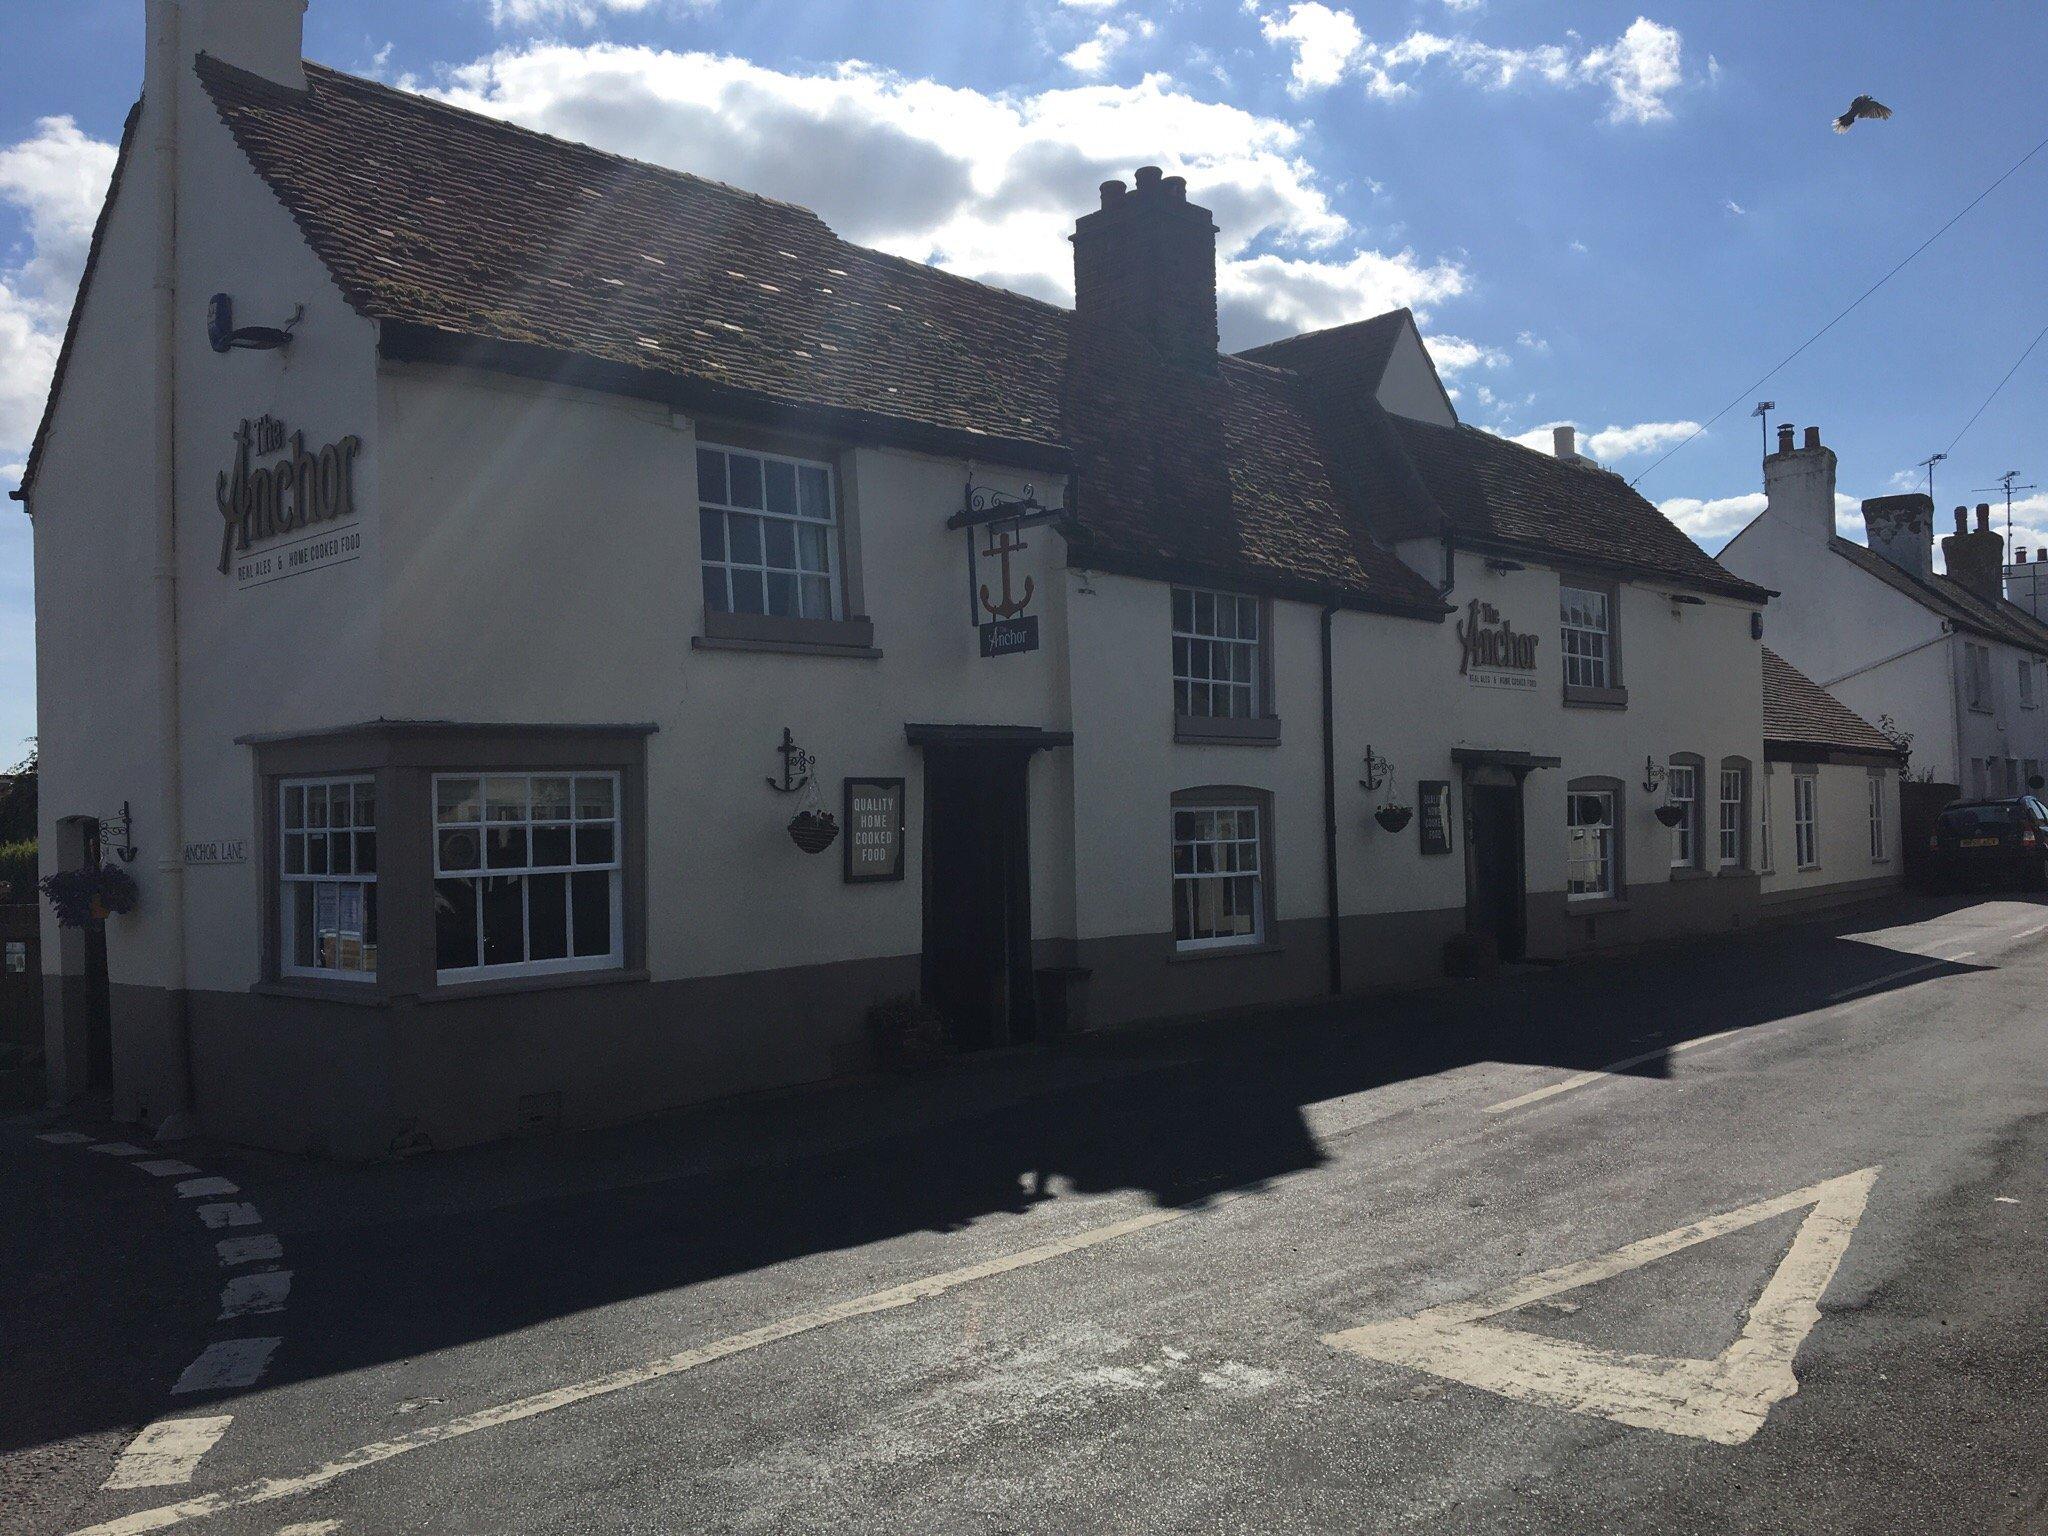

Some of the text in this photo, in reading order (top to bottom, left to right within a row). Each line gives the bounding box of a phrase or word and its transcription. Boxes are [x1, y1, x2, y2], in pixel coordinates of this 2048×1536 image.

[254, 413, 285, 457] The
[216, 418, 361, 575] Anchor
[238, 533, 360, 581] REAL ALES & HOME COOKED FOOD
[1481, 602, 1500, 624] The
[989, 626, 1027, 652] Anchor
[1457, 598, 1539, 676] Anchor
[854, 798, 894, 811] QUALITY
[861, 814, 887, 828] HOME
[855, 831, 892, 845] COOKED
[185, 842, 245, 861] ANCHOR LANE
[862, 848, 886, 861] FOOD
